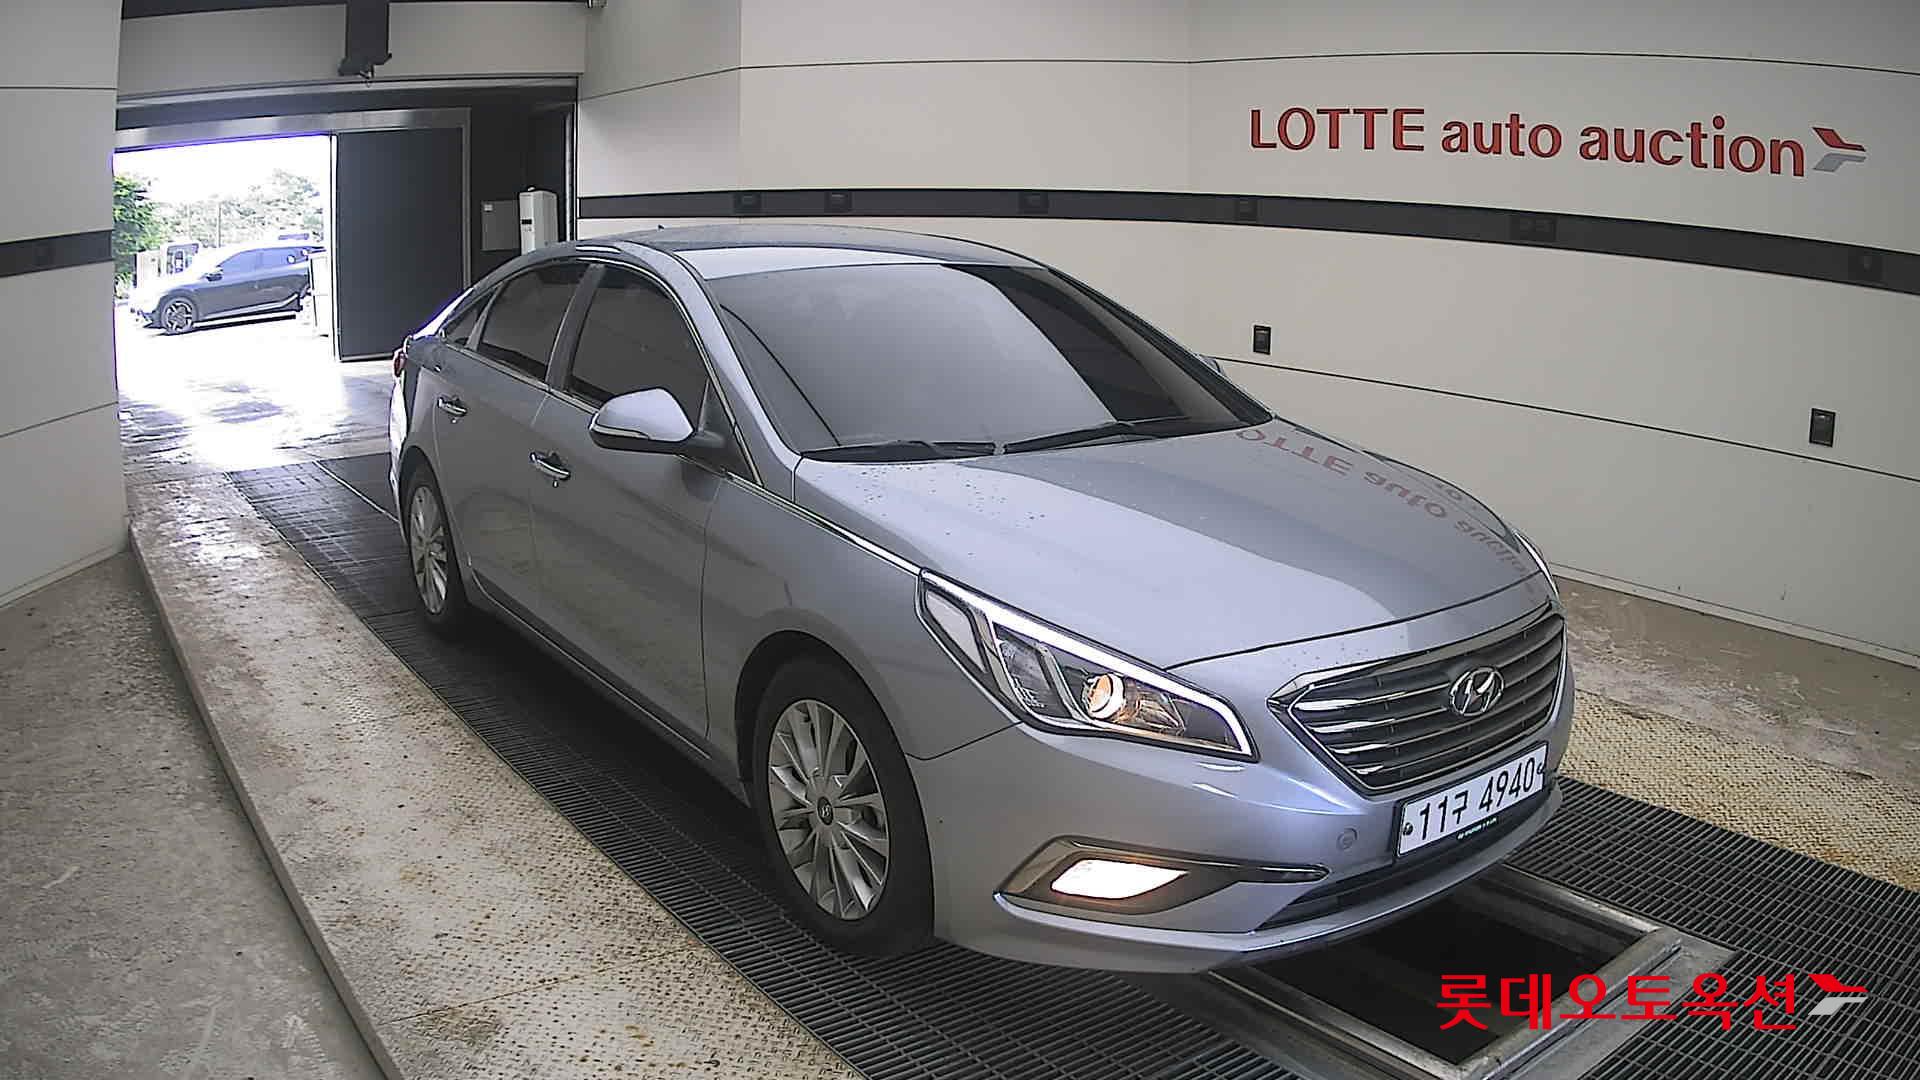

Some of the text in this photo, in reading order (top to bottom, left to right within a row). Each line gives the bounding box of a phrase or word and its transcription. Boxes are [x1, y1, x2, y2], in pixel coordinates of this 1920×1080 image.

[1250, 107, 1806, 177] LOTTE auto auction
[1419, 790, 1469, 840] 11구
[1478, 757, 1536, 812] 4940
